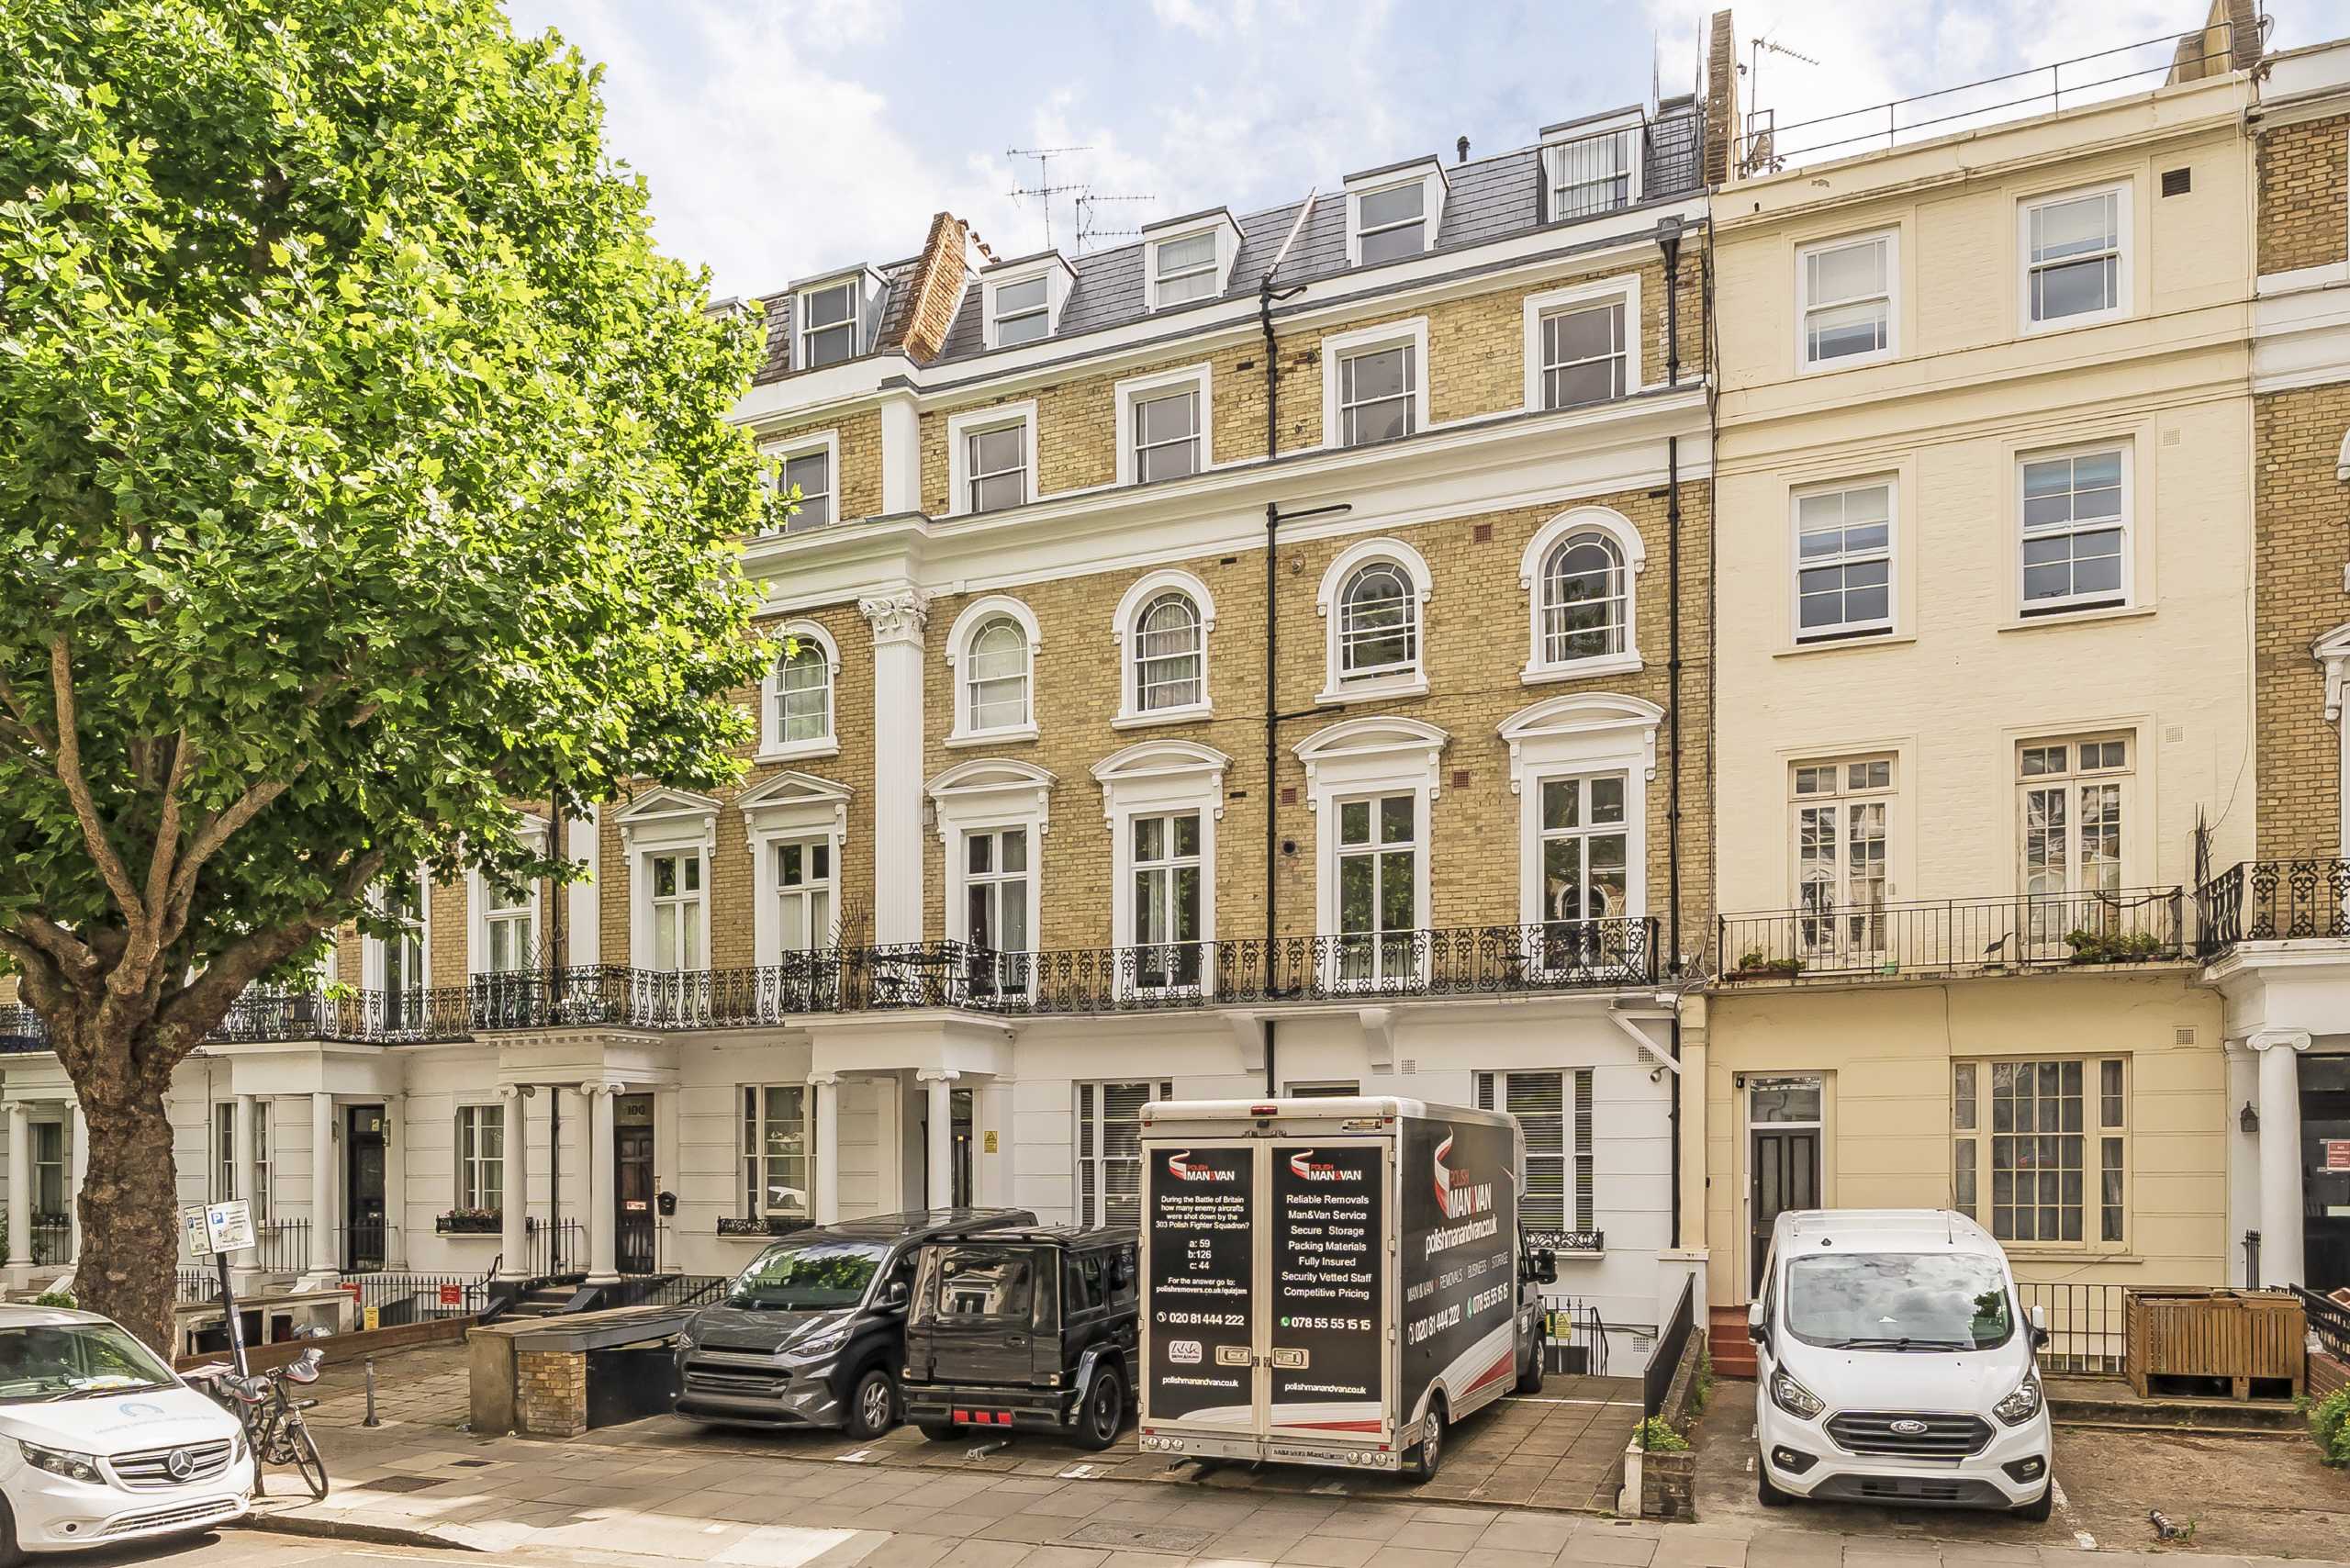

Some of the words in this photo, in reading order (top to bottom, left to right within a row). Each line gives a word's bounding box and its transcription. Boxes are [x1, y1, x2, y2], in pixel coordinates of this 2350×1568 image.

[1310, 1170, 1362, 1181] MAN&VAN
[1449, 1169, 1470, 1186] POLISH
[1161, 1195, 1182, 1204] During
[1223, 1195, 1244, 1204] Britain
[1287, 1195, 1322, 1204] Reliable
[1324, 1195, 1370, 1204] Removals
[1217, 1213, 1226, 1221] by
[1288, 1210, 1331, 1219] Man&Van
[1333, 1211, 1367, 1220] Service
[1190, 1221, 1213, 1230] Fighter
[1214, 1222, 1249, 1230] Squadron?
[1291, 1226, 1323, 1235] Secure
[1328, 1226, 1364, 1237] Storage
[1199, 1239, 1211, 1248] 59
[1288, 1241, 1323, 1252] Packing
[1326, 1241, 1367, 1251] Materials
[1198, 1261, 1210, 1270] 44
[1298, 1257, 1320, 1268] Fully
[1322, 1257, 1357, 1267] Insured
[1281, 1271, 1317, 1282] Security
[1319, 1272, 1348, 1282] Vetted
[1350, 1272, 1372, 1282] Staff
[1283, 1287, 1336, 1298] Competitive
[1338, 1288, 1370, 1300] Pricing
[1169, 1313, 1188, 1324] 020
[1225, 1315, 1245, 1326] 222
[1291, 1316, 1315, 1328] 078
[1314, 1317, 1328, 1328] 55
[1331, 1318, 1345, 1329] 55
[1347, 1318, 1358, 1330] 15
[1360, 1319, 1371, 1330] 15
[1415, 1317, 1427, 1342] 020
[1449, 1304, 1460, 1327] 222
